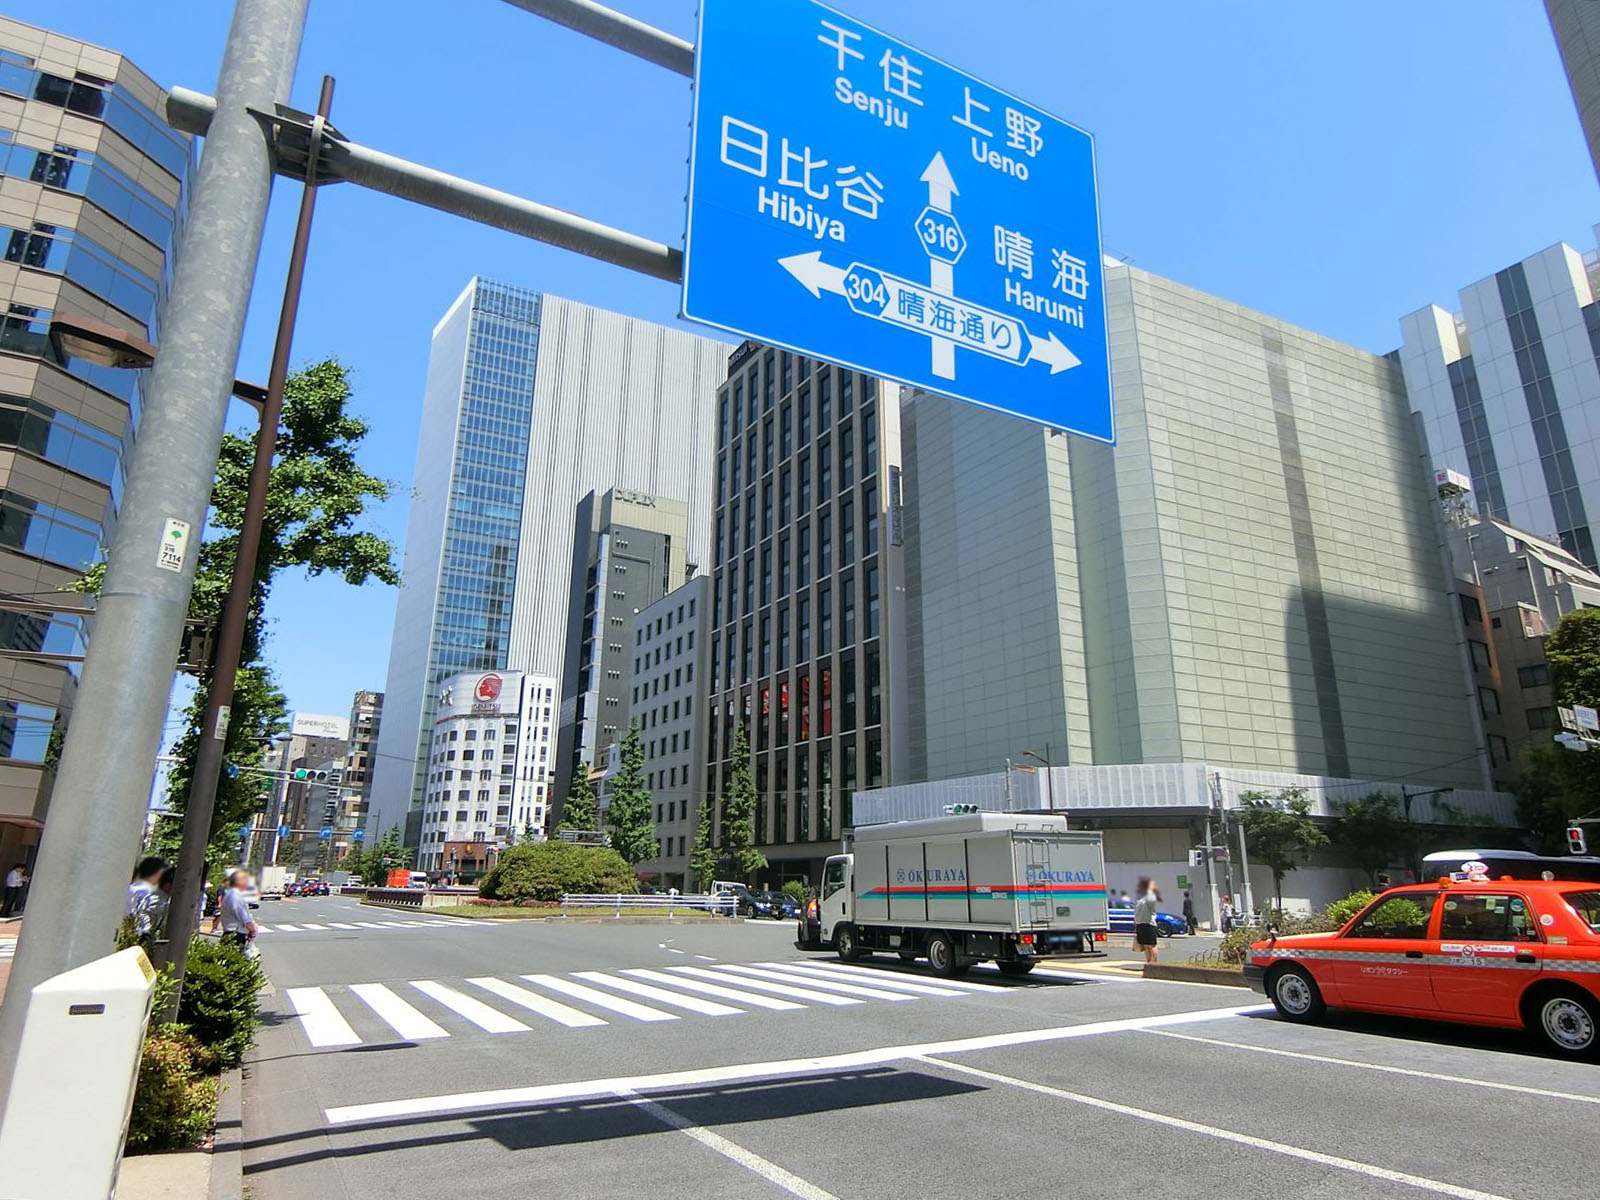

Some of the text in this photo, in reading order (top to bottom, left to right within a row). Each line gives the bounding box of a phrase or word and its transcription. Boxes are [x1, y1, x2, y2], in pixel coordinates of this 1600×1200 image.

[817, 19, 924, 106] 千住
[835, 77, 908, 129] Senju
[952, 86, 1043, 157] 上野
[720, 115, 884, 220] 日比谷
[971, 136, 1029, 181] Ueno
[758, 186, 845, 242] Hibiya
[923, 218, 959, 253] 316
[994, 224, 1090, 300] 晴海
[848, 273, 886, 309] 304
[1004, 278, 1084, 329] Harumi
[898, 292, 1013, 351] 晴海通り
[908, 868, 966, 883] OKURAYA
[1038, 870, 1095, 883] OKURAYA
